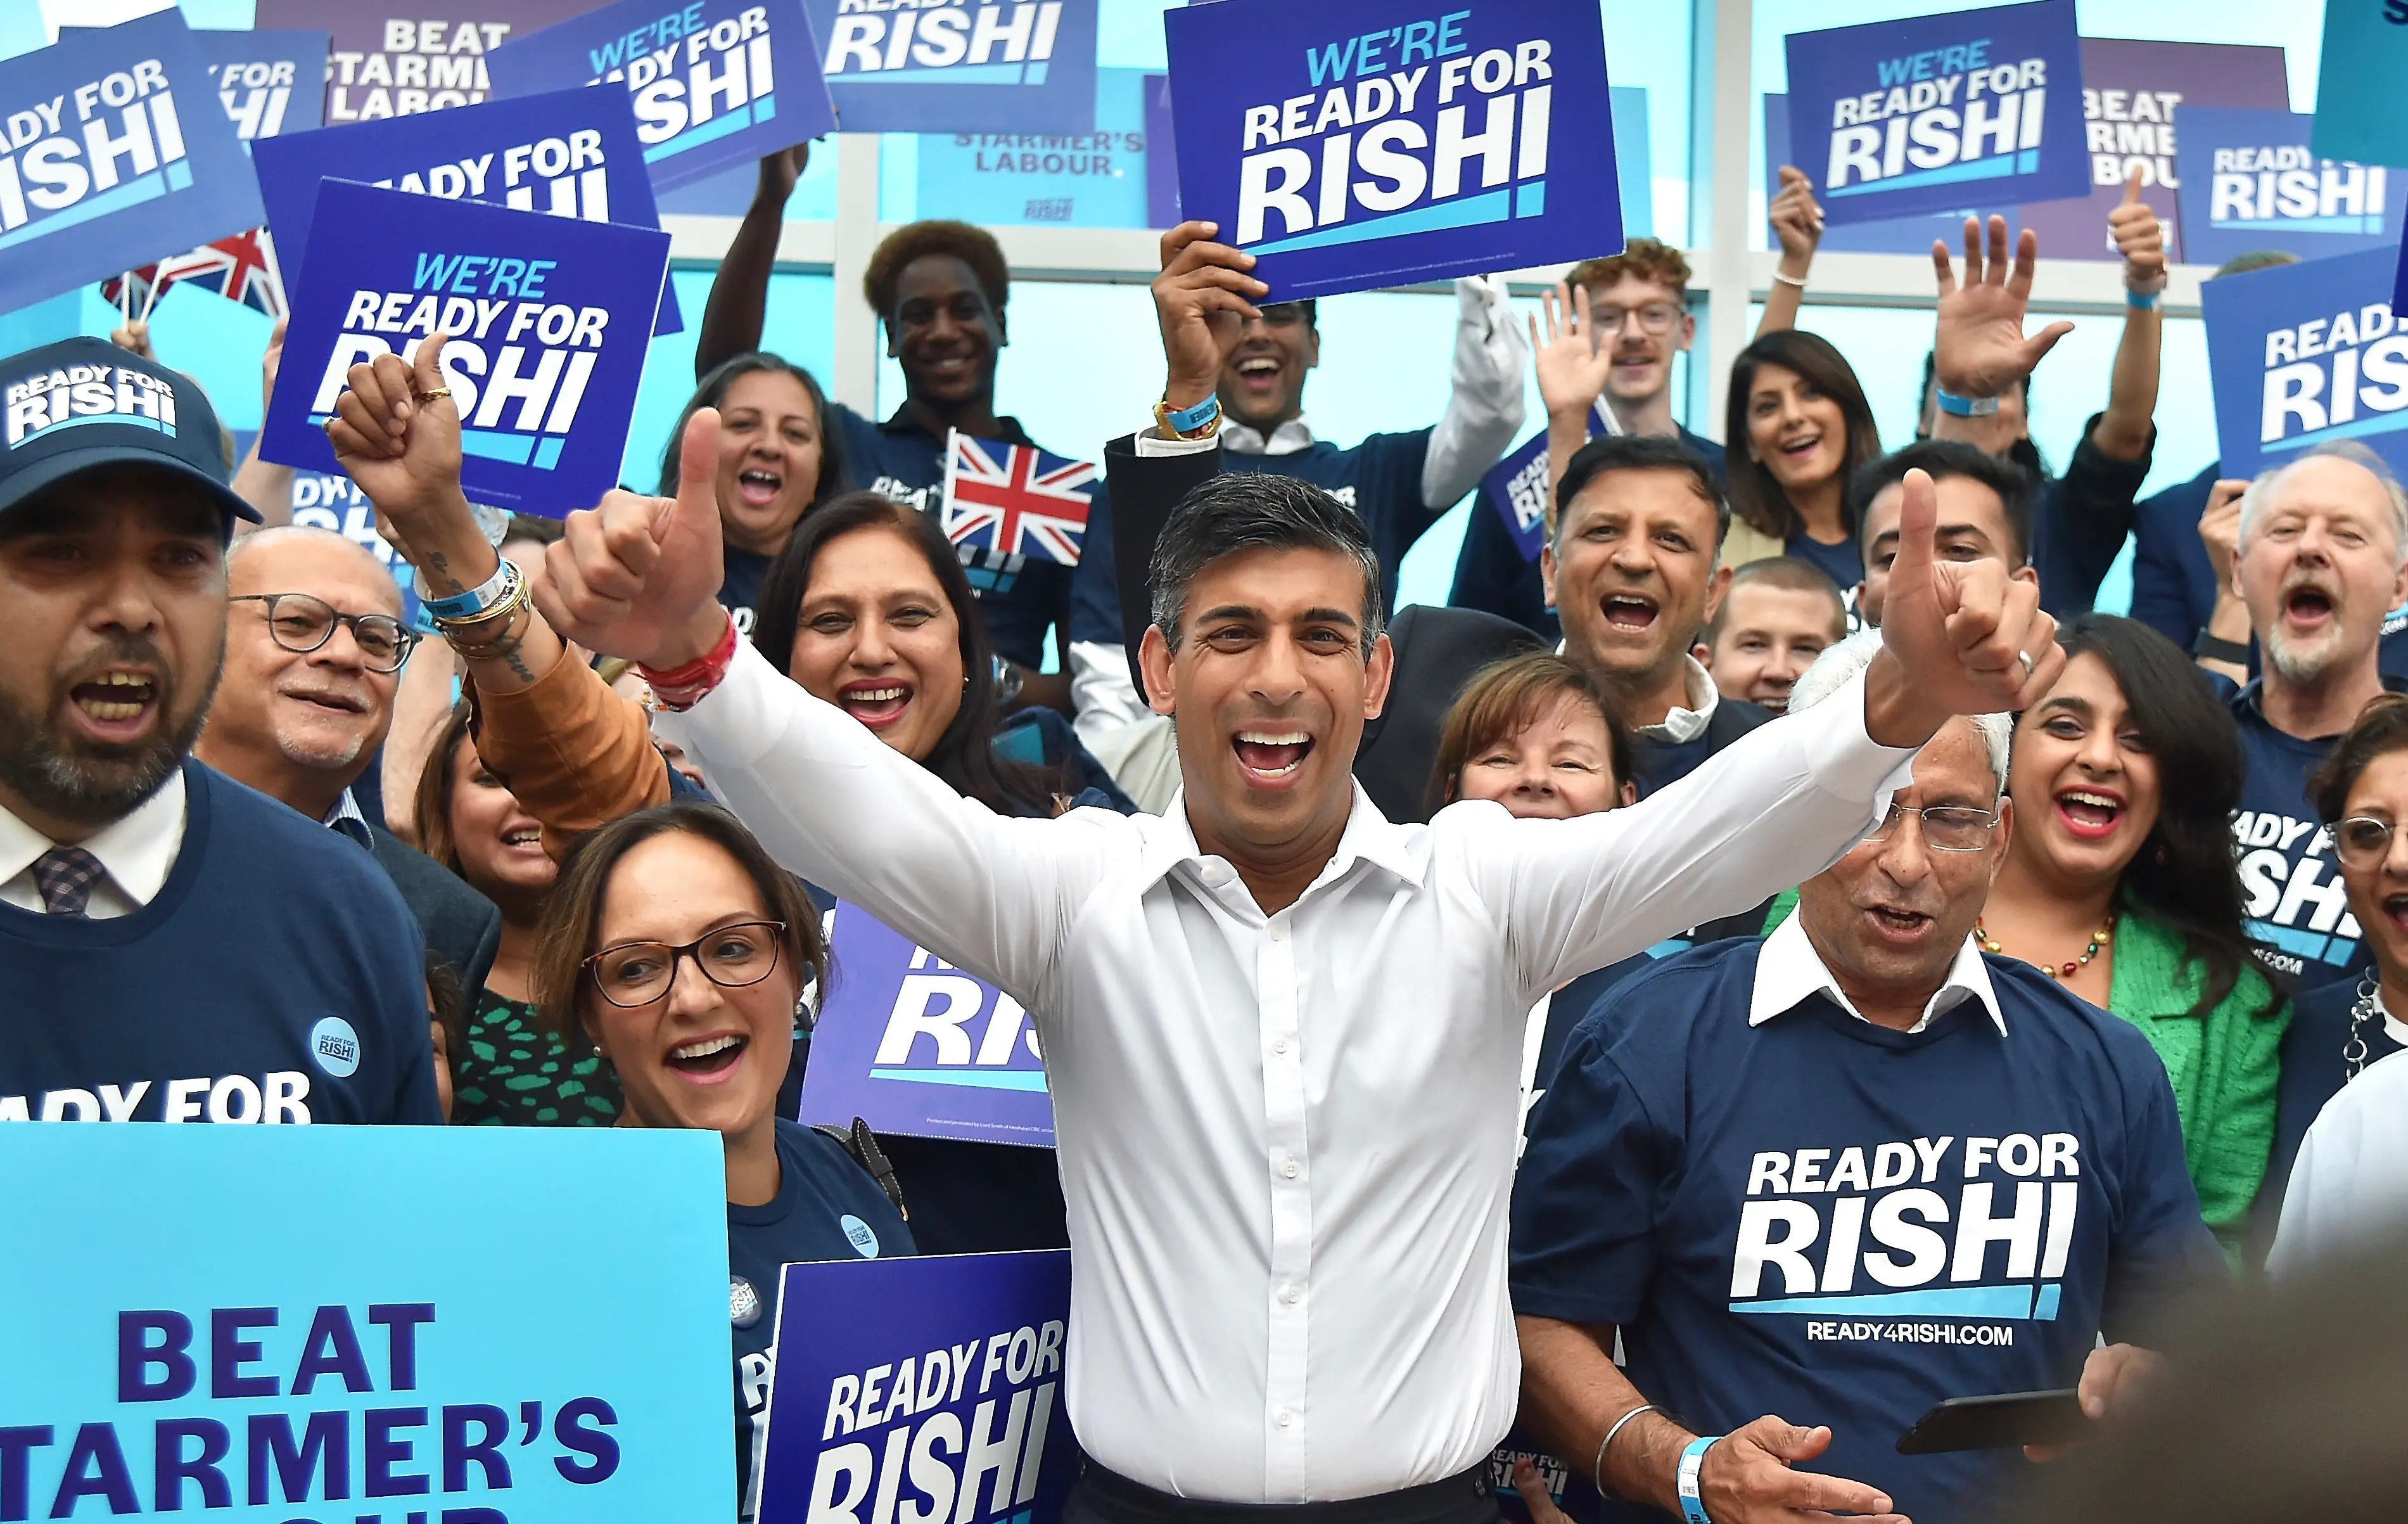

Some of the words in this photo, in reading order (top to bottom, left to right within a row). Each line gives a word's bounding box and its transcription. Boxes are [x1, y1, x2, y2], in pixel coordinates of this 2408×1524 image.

[384, 19, 511, 56] BEAT
[589, 0, 706, 75] WE'RE
[687, 5, 770, 66] FOR
[1306, 10, 1471, 87] WE'RE
[1877, 39, 1992, 88] WE'RE
[74, 58, 170, 122] FOR
[220, 60, 296, 90] FOR
[634, 32, 774, 144] SHI
[1243, 66, 1429, 151] READY
[1438, 39, 1553, 105] FOR
[1832, 75, 1962, 128] READY
[1965, 58, 2048, 100] FOR
[0, 90, 186, 231] ISHI
[504, 129, 606, 188] FOR
[1236, 85, 1553, 246] RISHI
[1826, 88, 2047, 190] RISHI
[413, 252, 557, 299] WE'RE
[343, 290, 509, 339] READY
[507, 303, 609, 348] FOR
[2265, 303, 2408, 368] READ
[8, 365, 113, 404] READY
[117, 368, 174, 399] FOR
[8, 381, 177, 445] RISHI
[2260, 336, 2408, 443] RIS
[321, 1034, 343, 1044] READY
[165, 1070, 312, 1124] FOR
[1746, 1136, 1954, 1195] READY
[1964, 1132, 2079, 1177] FOR
[1730, 1181, 2078, 1298] RISHI
[118, 1302, 436, 1403] BEAT
[1807, 1321, 2013, 1347] READY4RISHI.COM
[822, 1338, 981, 1442] READY
[978, 1320, 1064, 1394] FOR
[0, 1396, 621, 1522] TARMER'S
